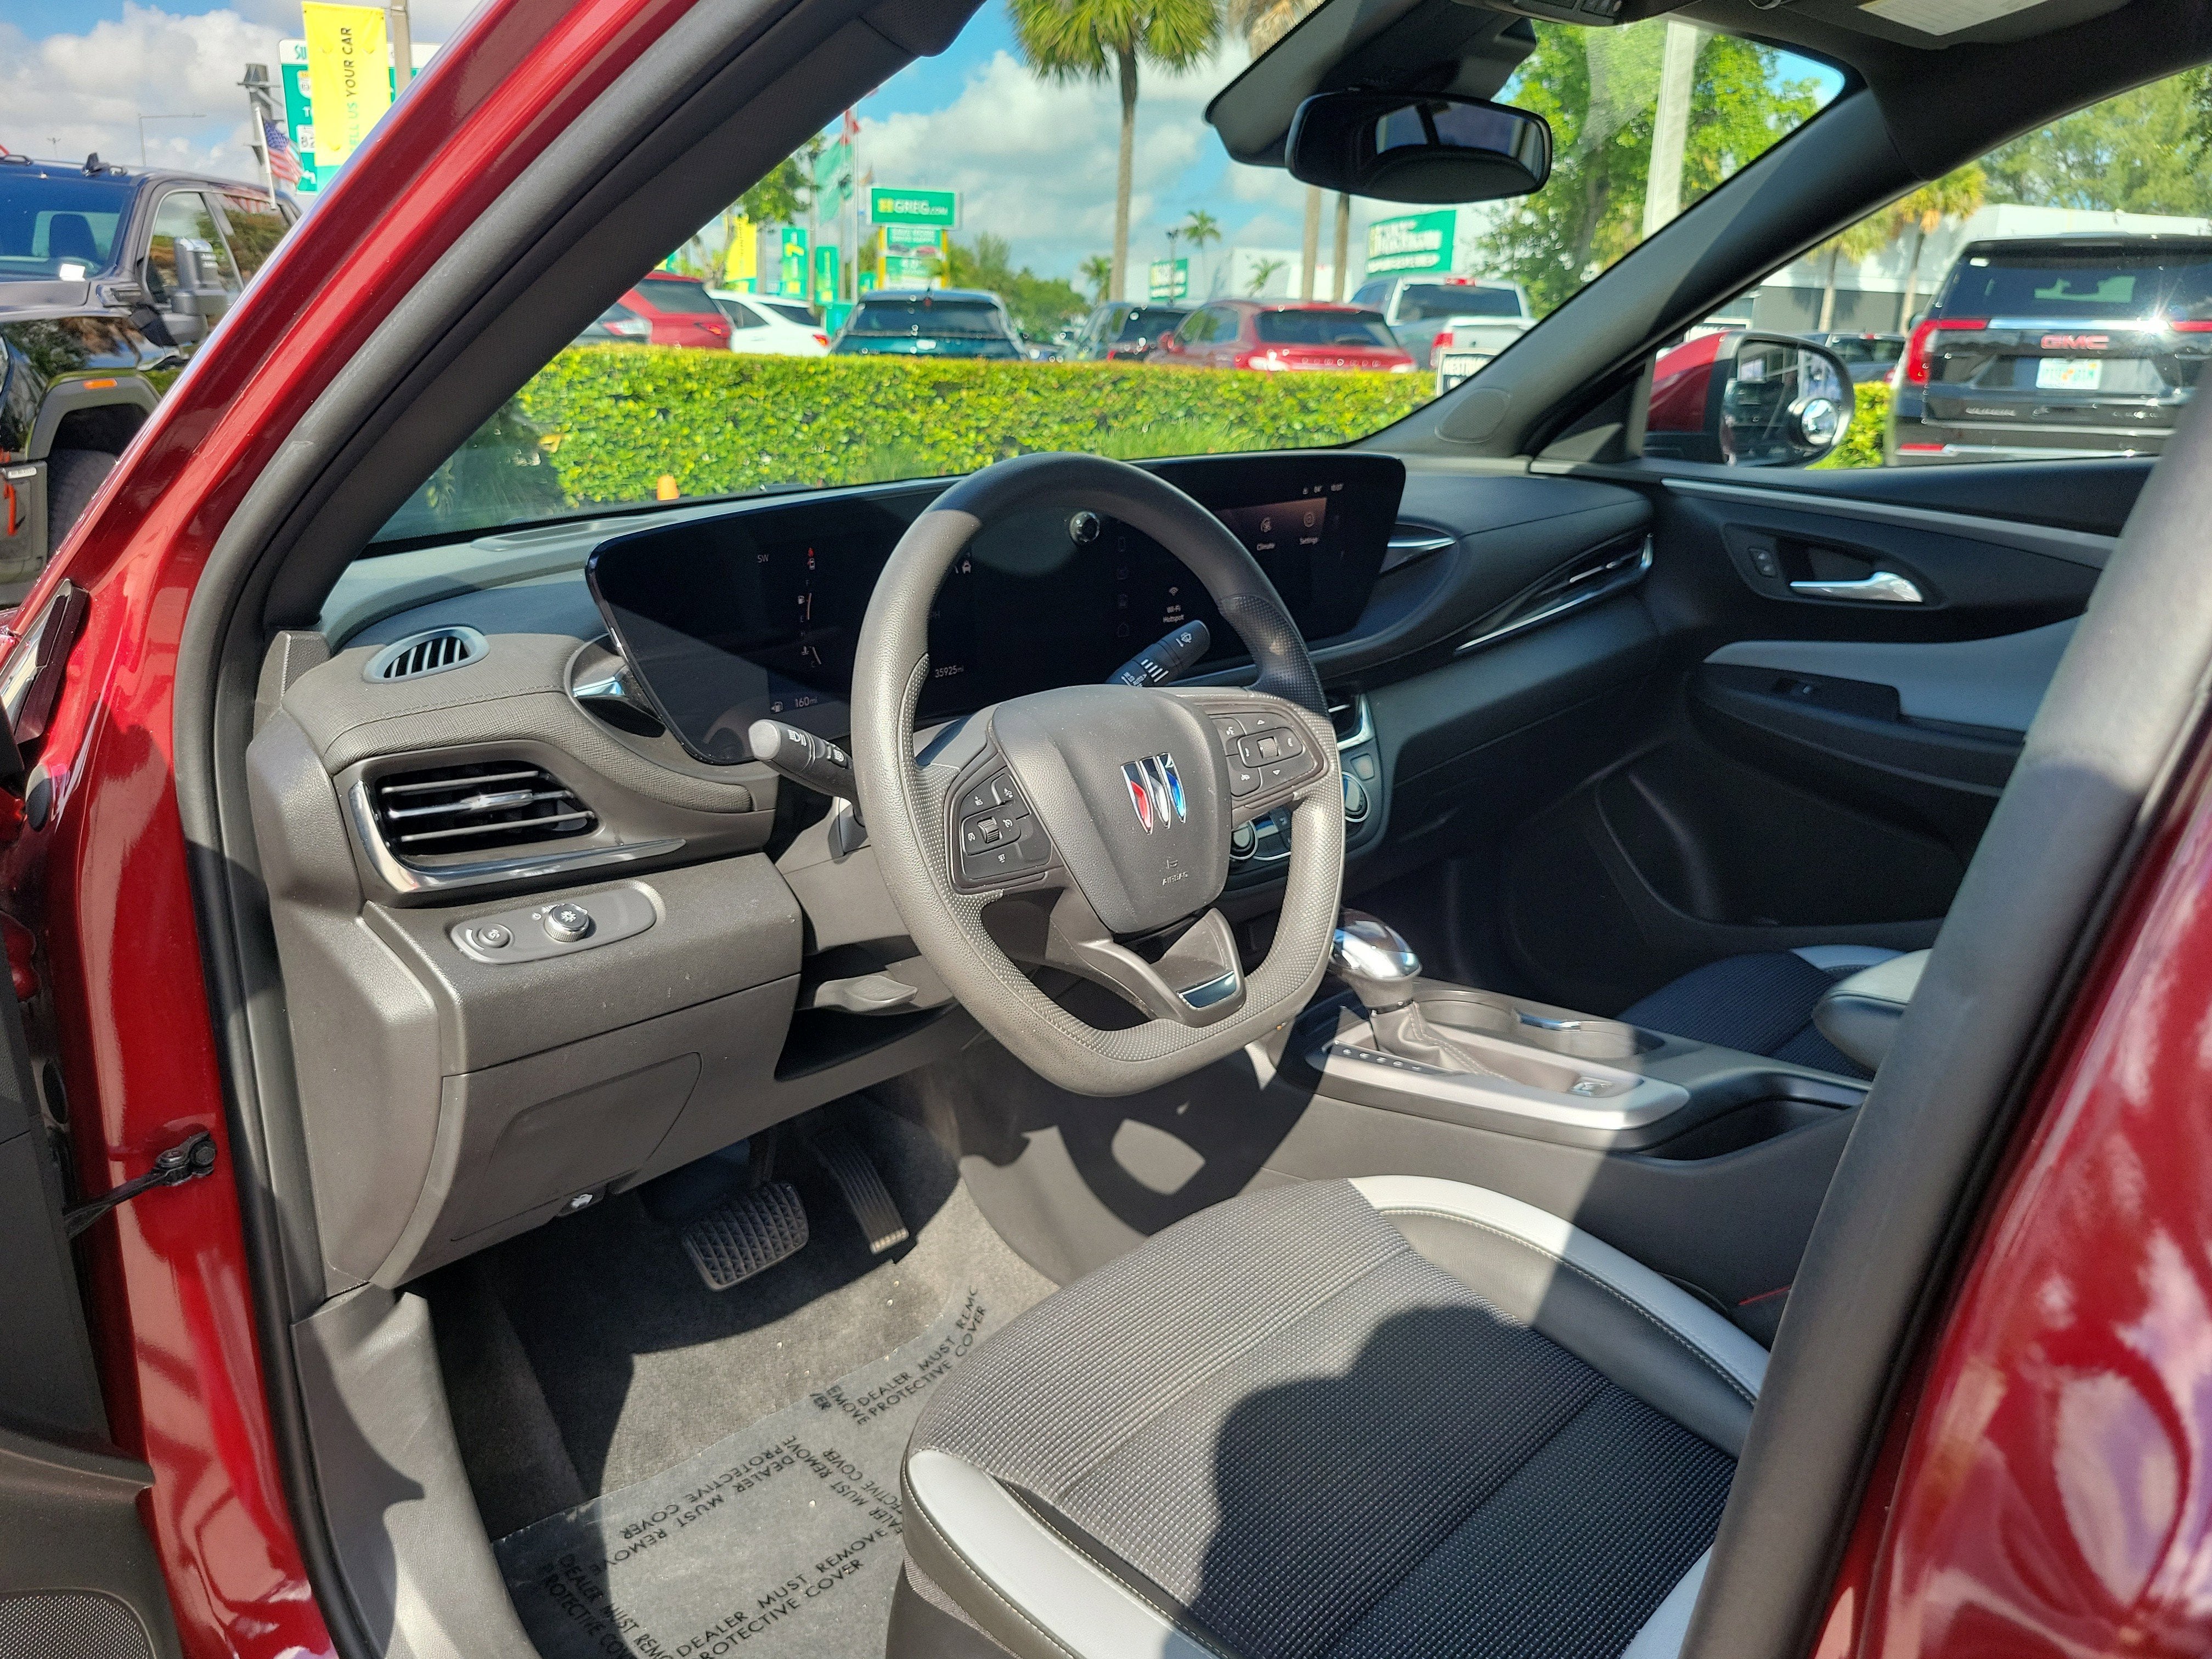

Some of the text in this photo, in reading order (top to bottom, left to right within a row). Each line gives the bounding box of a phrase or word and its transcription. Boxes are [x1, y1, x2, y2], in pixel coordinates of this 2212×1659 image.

[341, 27, 353, 55] CAR
[344, 59, 357, 97] YOUR
[348, 101, 358, 119] US
[2041, 335, 2109, 350] GMC
[758, 554, 769, 563] SW
[857, 1372, 912, 1406] DEALER
[917, 1335, 956, 1371] MUST
[868, 1305, 986, 1417] PROTECTIVE COVER
[732, 1455, 795, 1493] DEALER
[783, 1435, 832, 1479] REMOVE
[822, 1448, 863, 1481] COVER
[619, 1444, 783, 1539] PROTECTIVE COVER
[676, 1494, 725, 1527] MUST
[830, 1481, 868, 1506] MUST
[676, 1528, 888, 1657] DEALER MUST REMOVE
[693, 1559, 864, 1659] ROTECTIVE COVER
